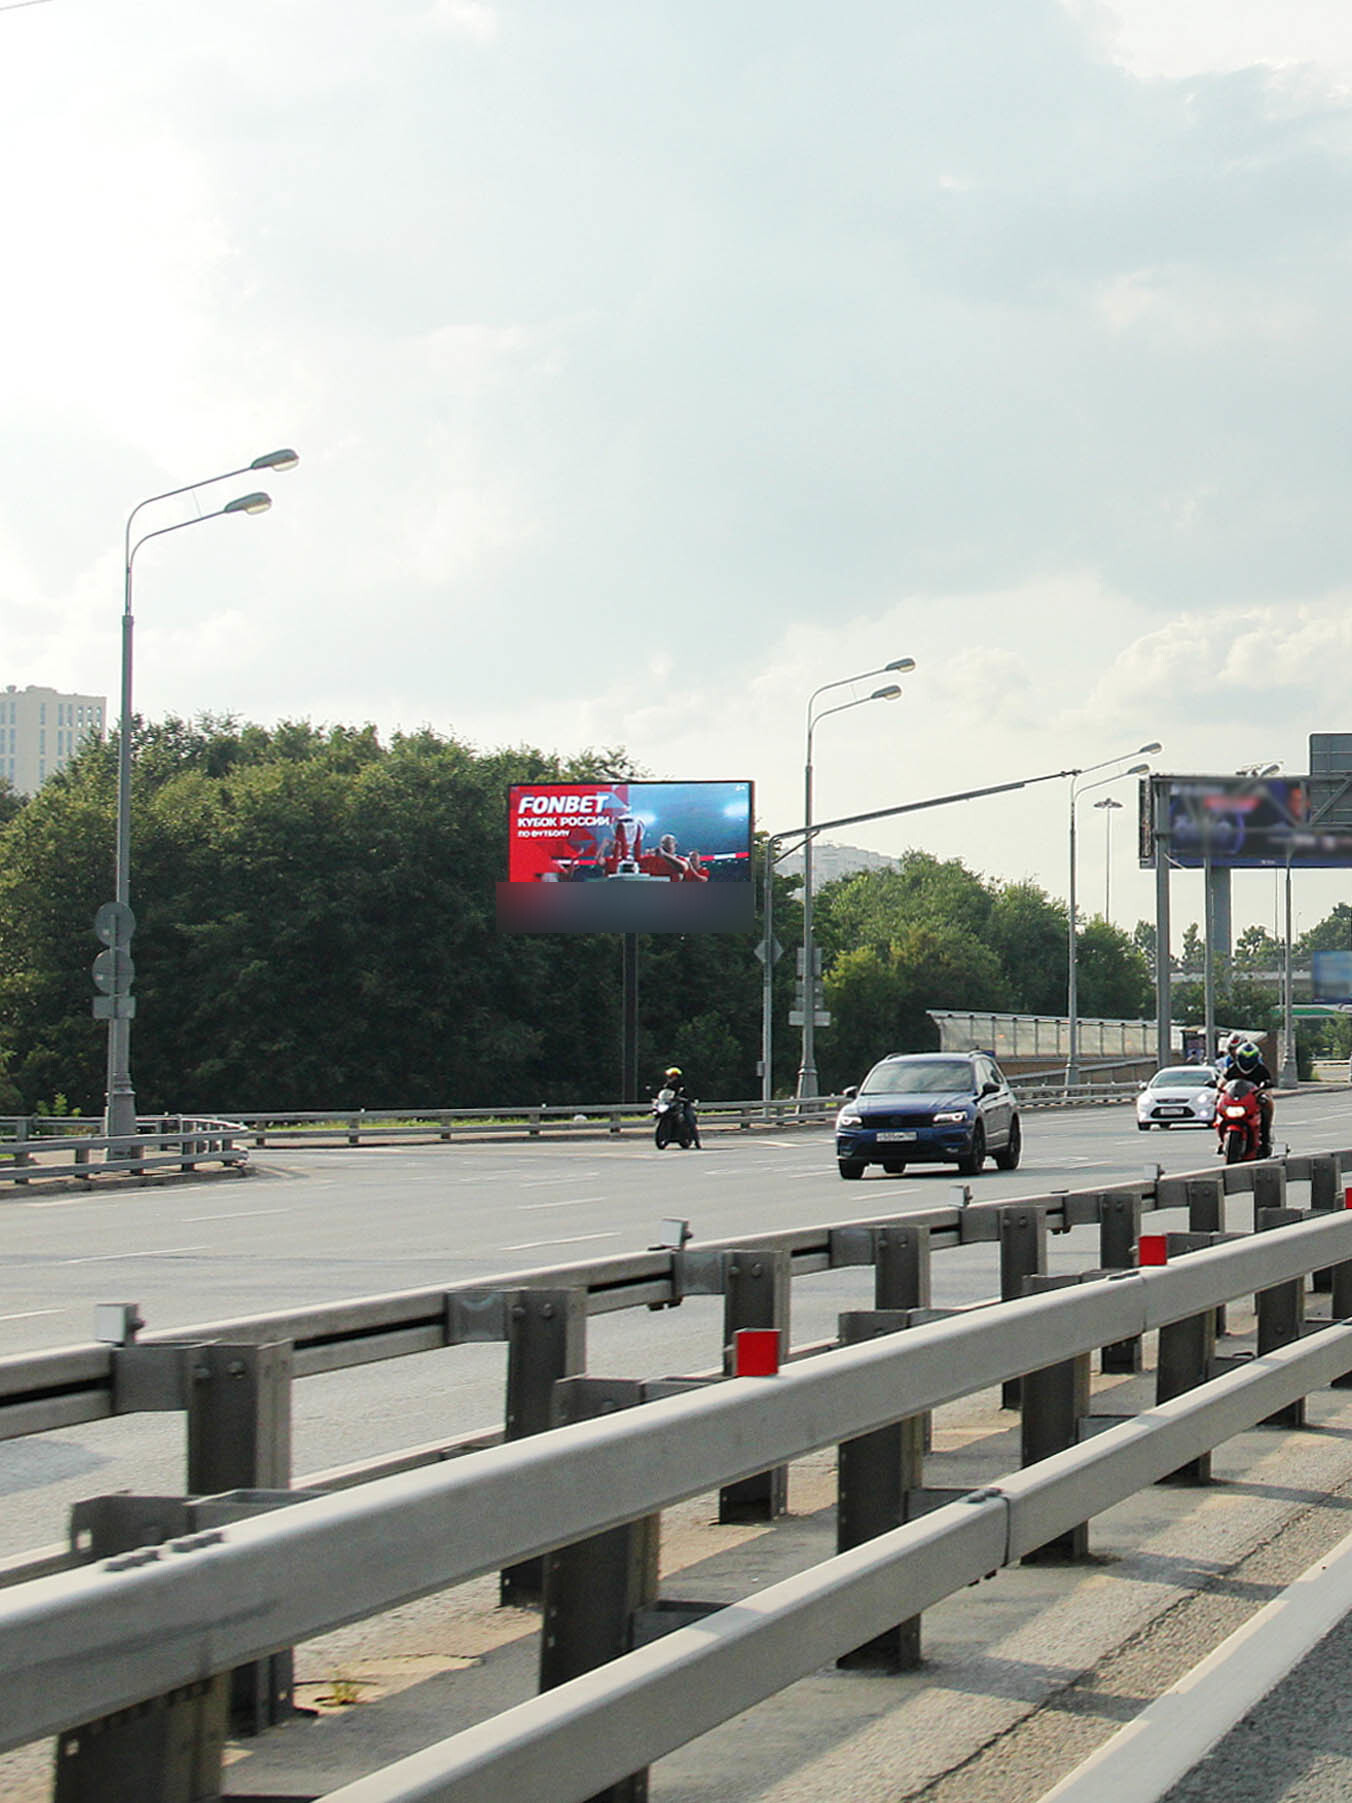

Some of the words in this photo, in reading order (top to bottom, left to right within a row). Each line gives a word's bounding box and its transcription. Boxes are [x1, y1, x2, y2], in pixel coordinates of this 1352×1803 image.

[518, 795, 609, 814] FONBET
[517, 817, 557, 827] КУБОК
[560, 816, 610, 826] РОССИИ
